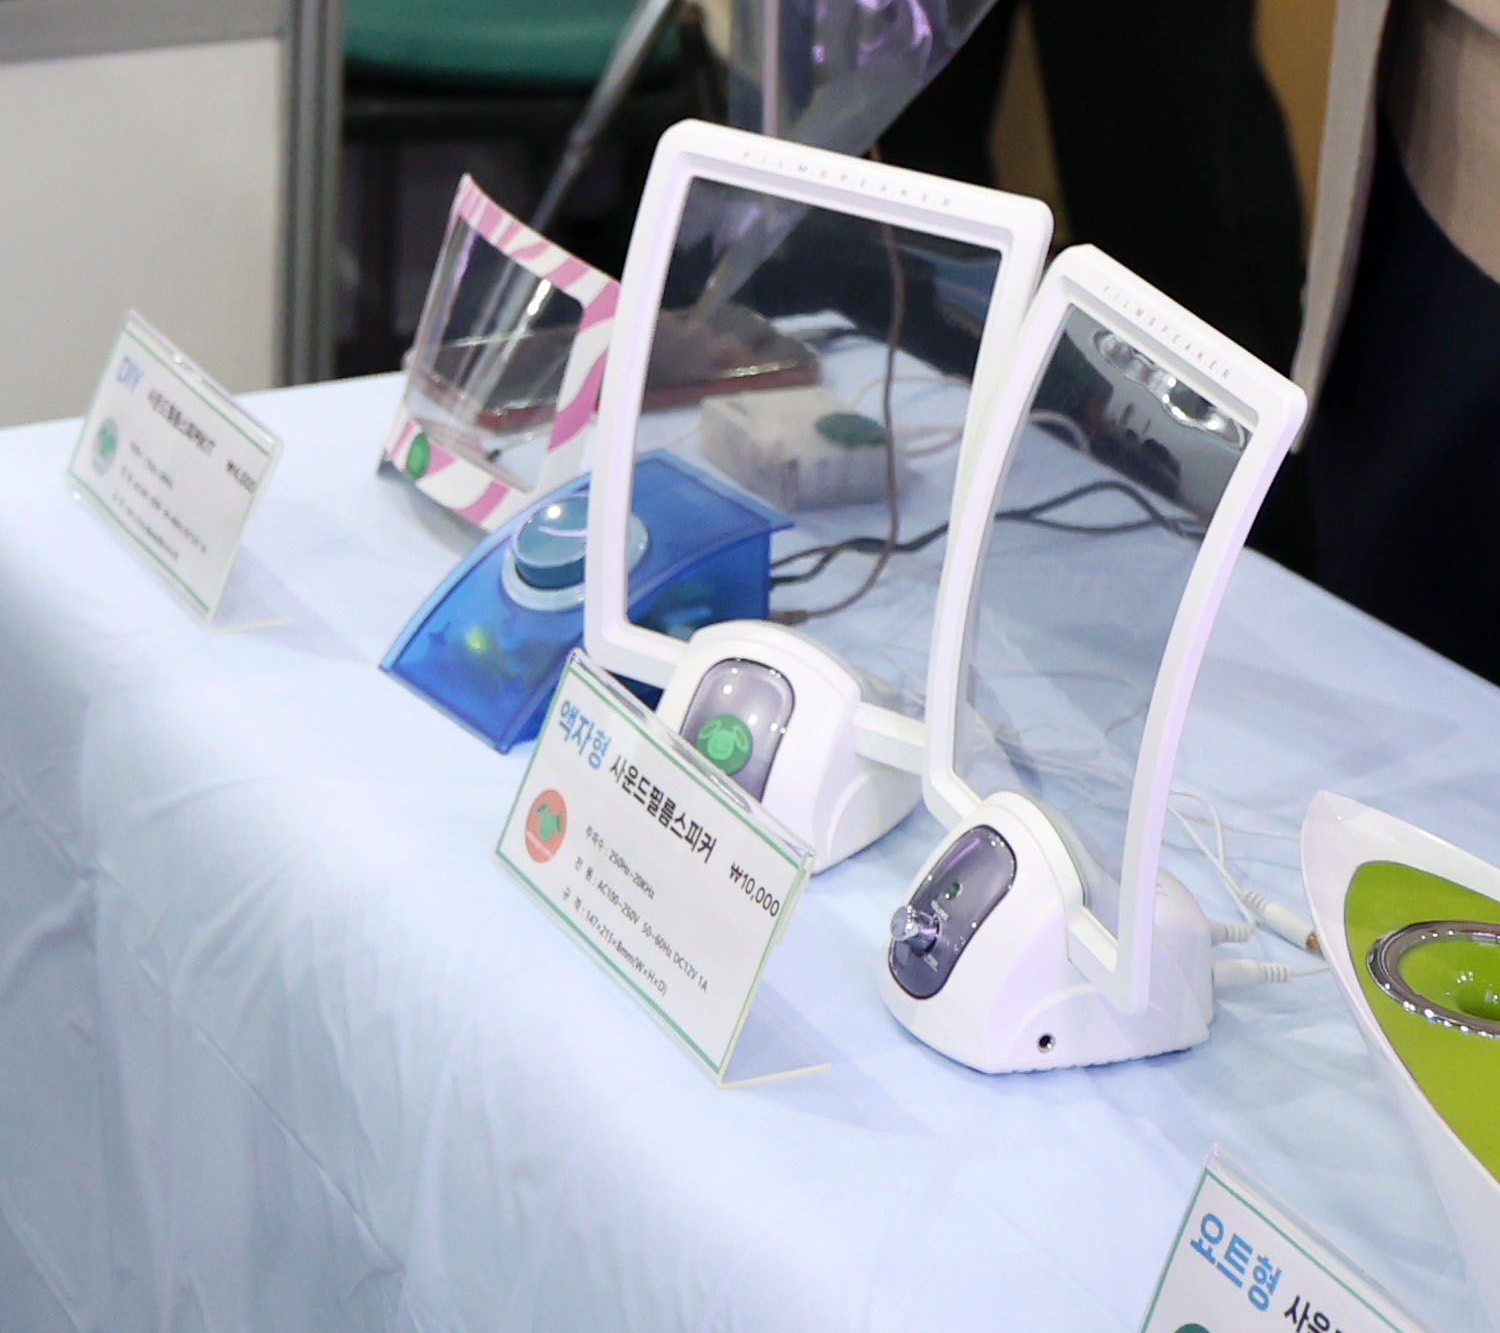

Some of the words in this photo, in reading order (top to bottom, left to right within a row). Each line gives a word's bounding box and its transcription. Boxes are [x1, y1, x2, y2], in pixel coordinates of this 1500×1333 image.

[559, 699, 612, 770] 액자형
[608, 753, 718, 864] 사운드필름스피커
[696, 974, 709, 992] 1A
[1189, 1213, 1283, 1312] 요트형
